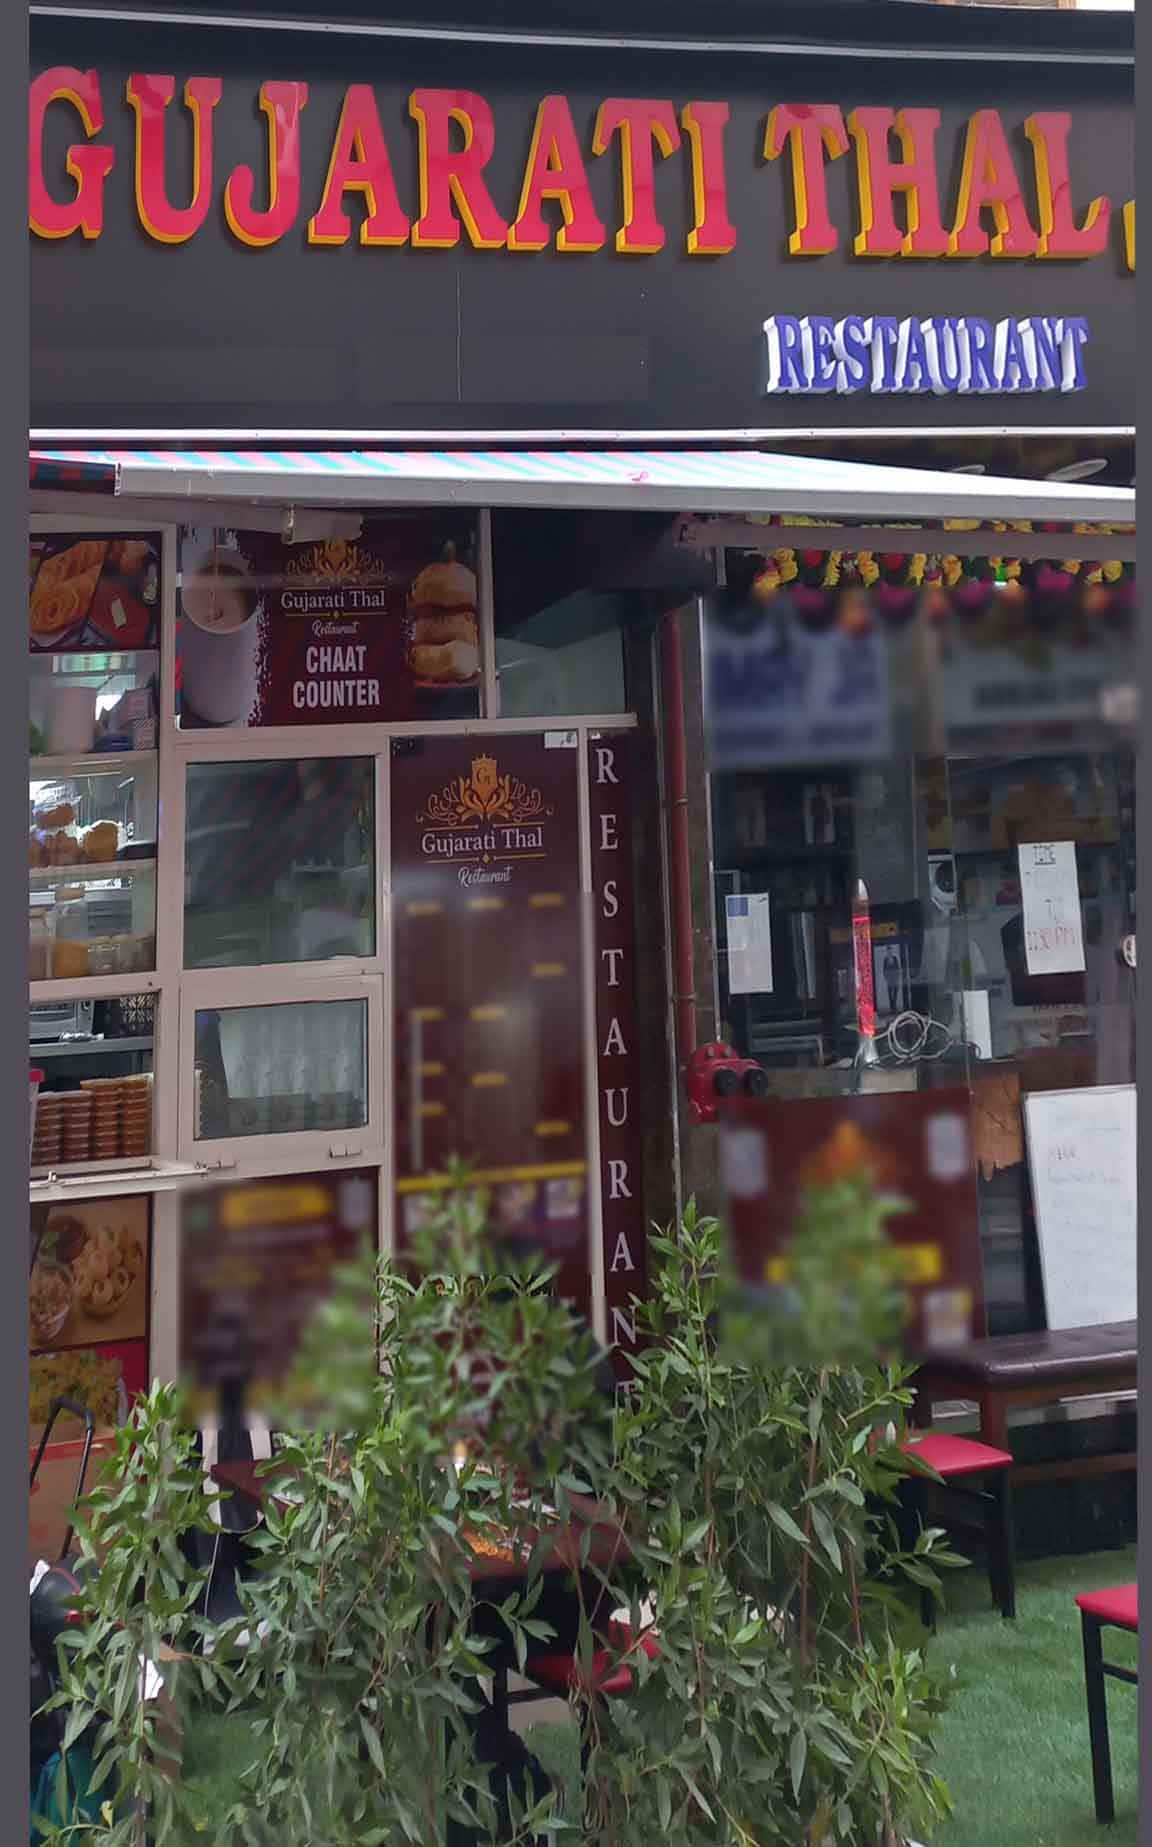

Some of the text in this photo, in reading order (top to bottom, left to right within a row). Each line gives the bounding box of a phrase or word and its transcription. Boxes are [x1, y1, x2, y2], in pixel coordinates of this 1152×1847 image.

[29, 66, 737, 255] GUJARATI
[763, 104, 1111, 258] THAL
[763, 315, 1088, 394] RESTAURANT
[281, 590, 385, 612] Gujarati Thal
[311, 619, 360, 637] Restaurant
[306, 645, 367, 673] CHAAT
[292, 679, 380, 709] COUNTER
[421, 827, 543, 857] Gujarati Thal
[457, 865, 514, 888] Restaurant
